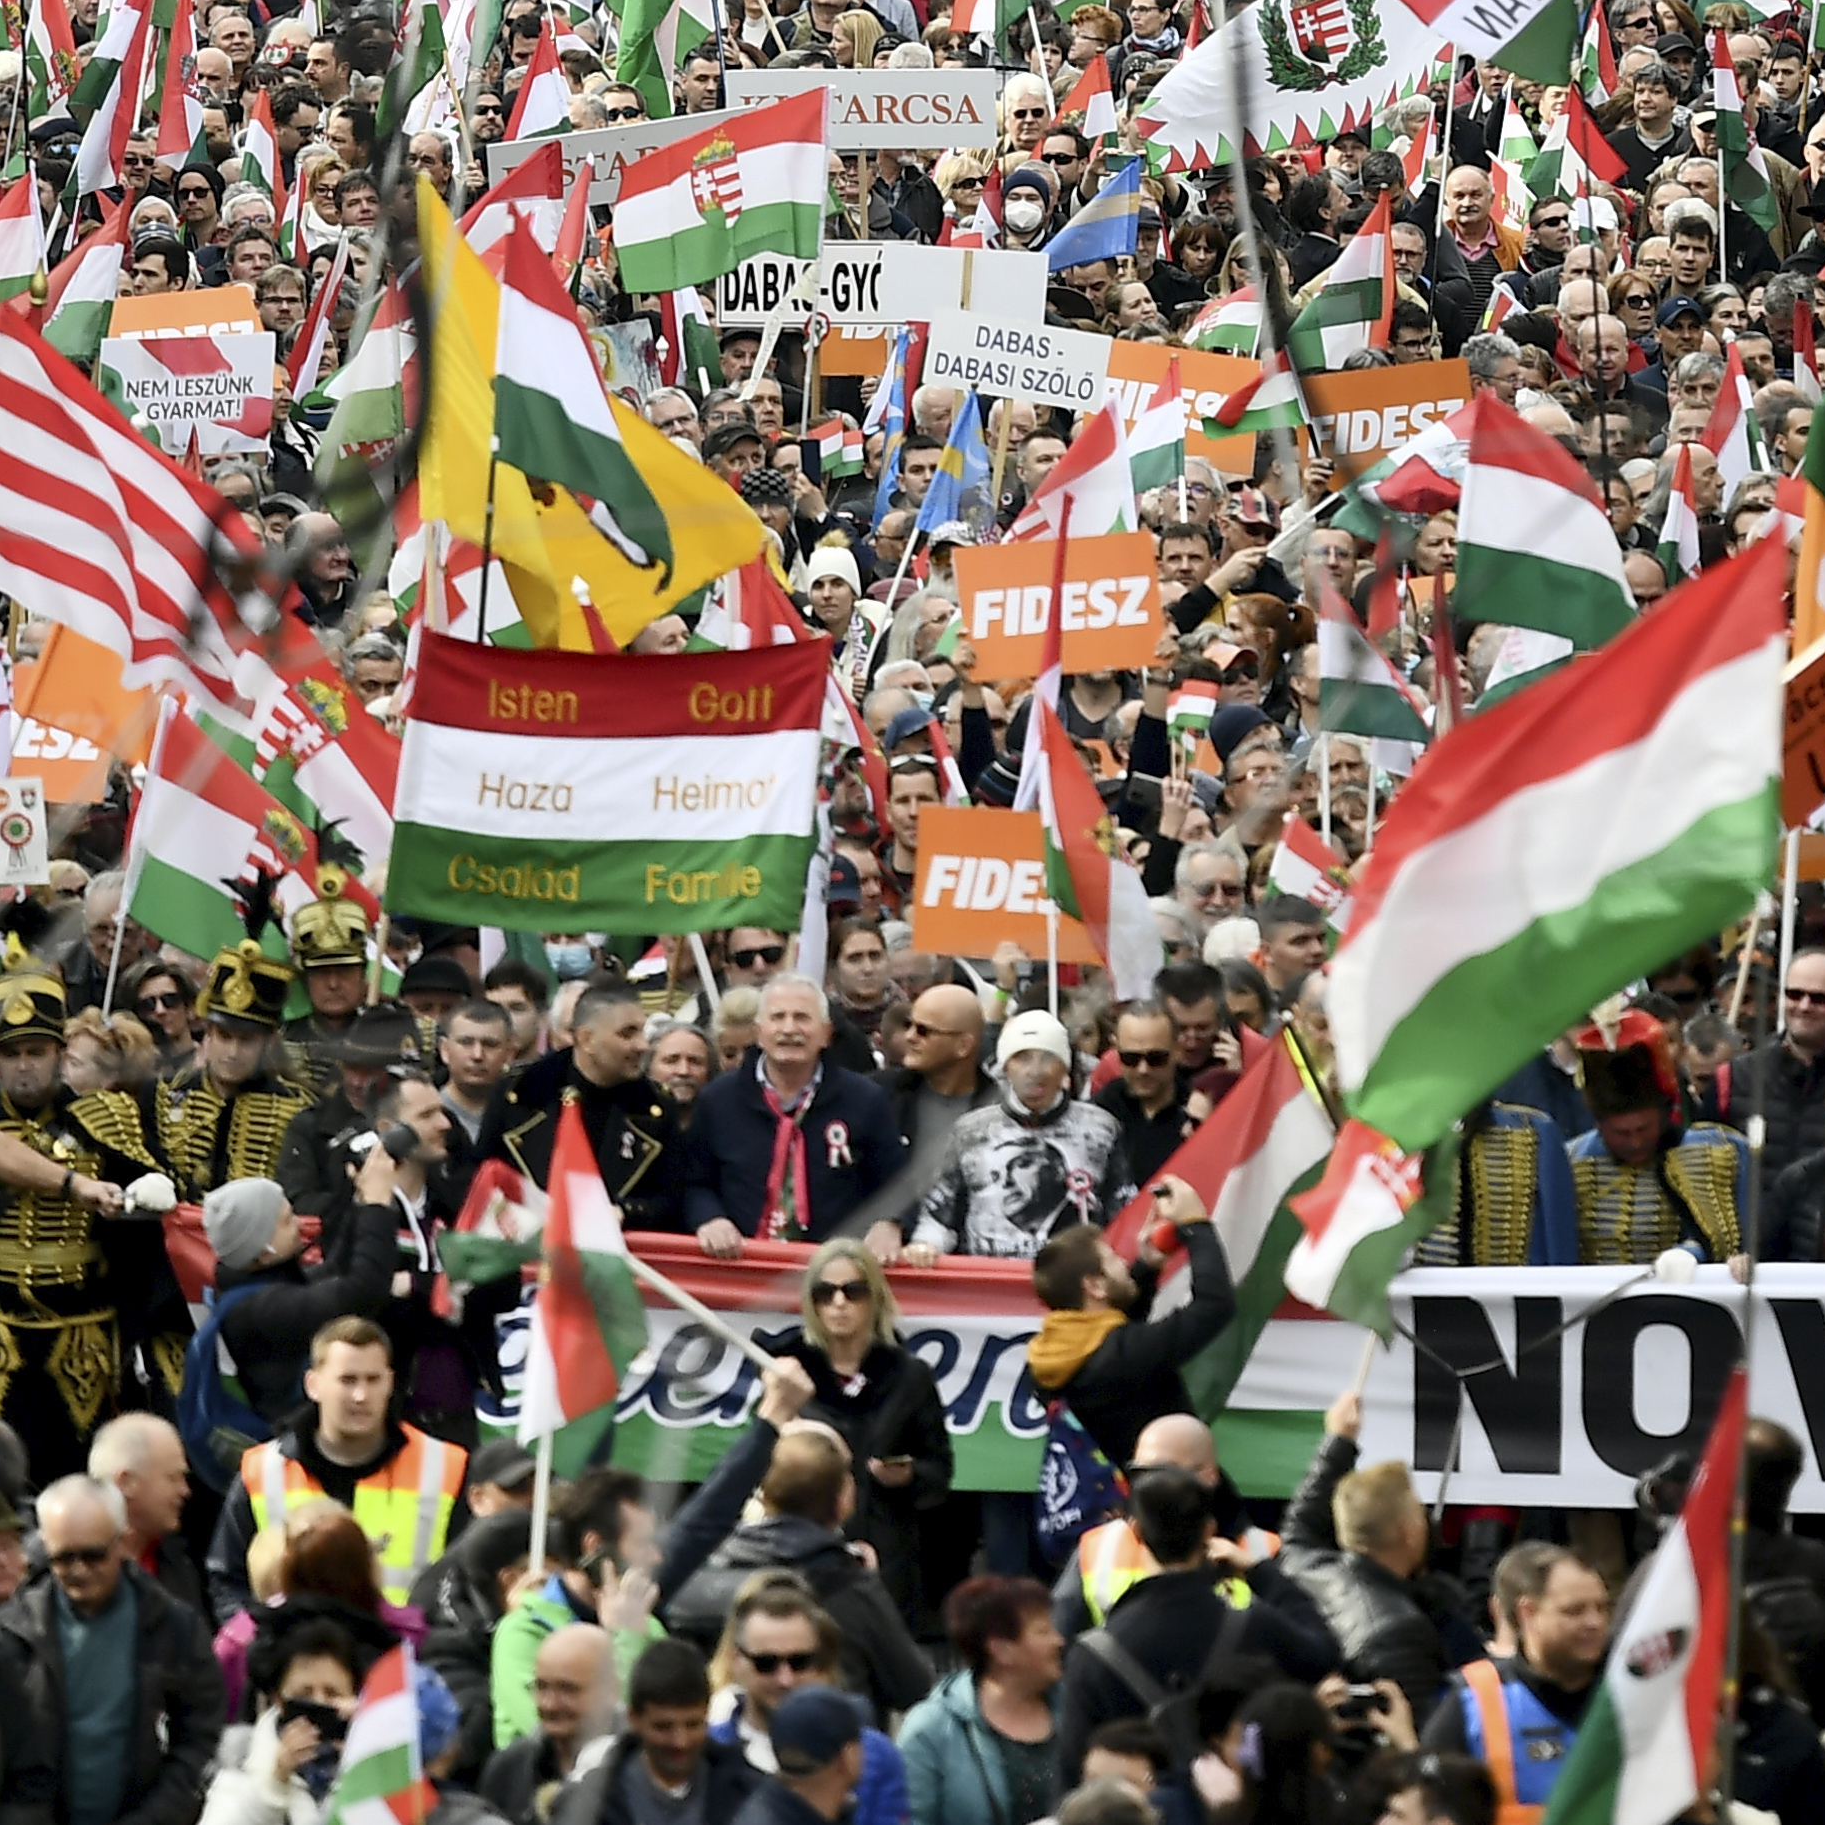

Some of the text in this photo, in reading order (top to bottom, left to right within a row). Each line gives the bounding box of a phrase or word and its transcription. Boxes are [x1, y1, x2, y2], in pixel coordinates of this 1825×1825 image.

[975, 327, 1049, 357] DABAS
[127, 375, 254, 399] NEM LESZÜNK
[932, 353, 1095, 401] DABASI SZŐLŐ
[147, 397, 241, 425] GYARMAT!
[480, 771, 574, 812] Haza
